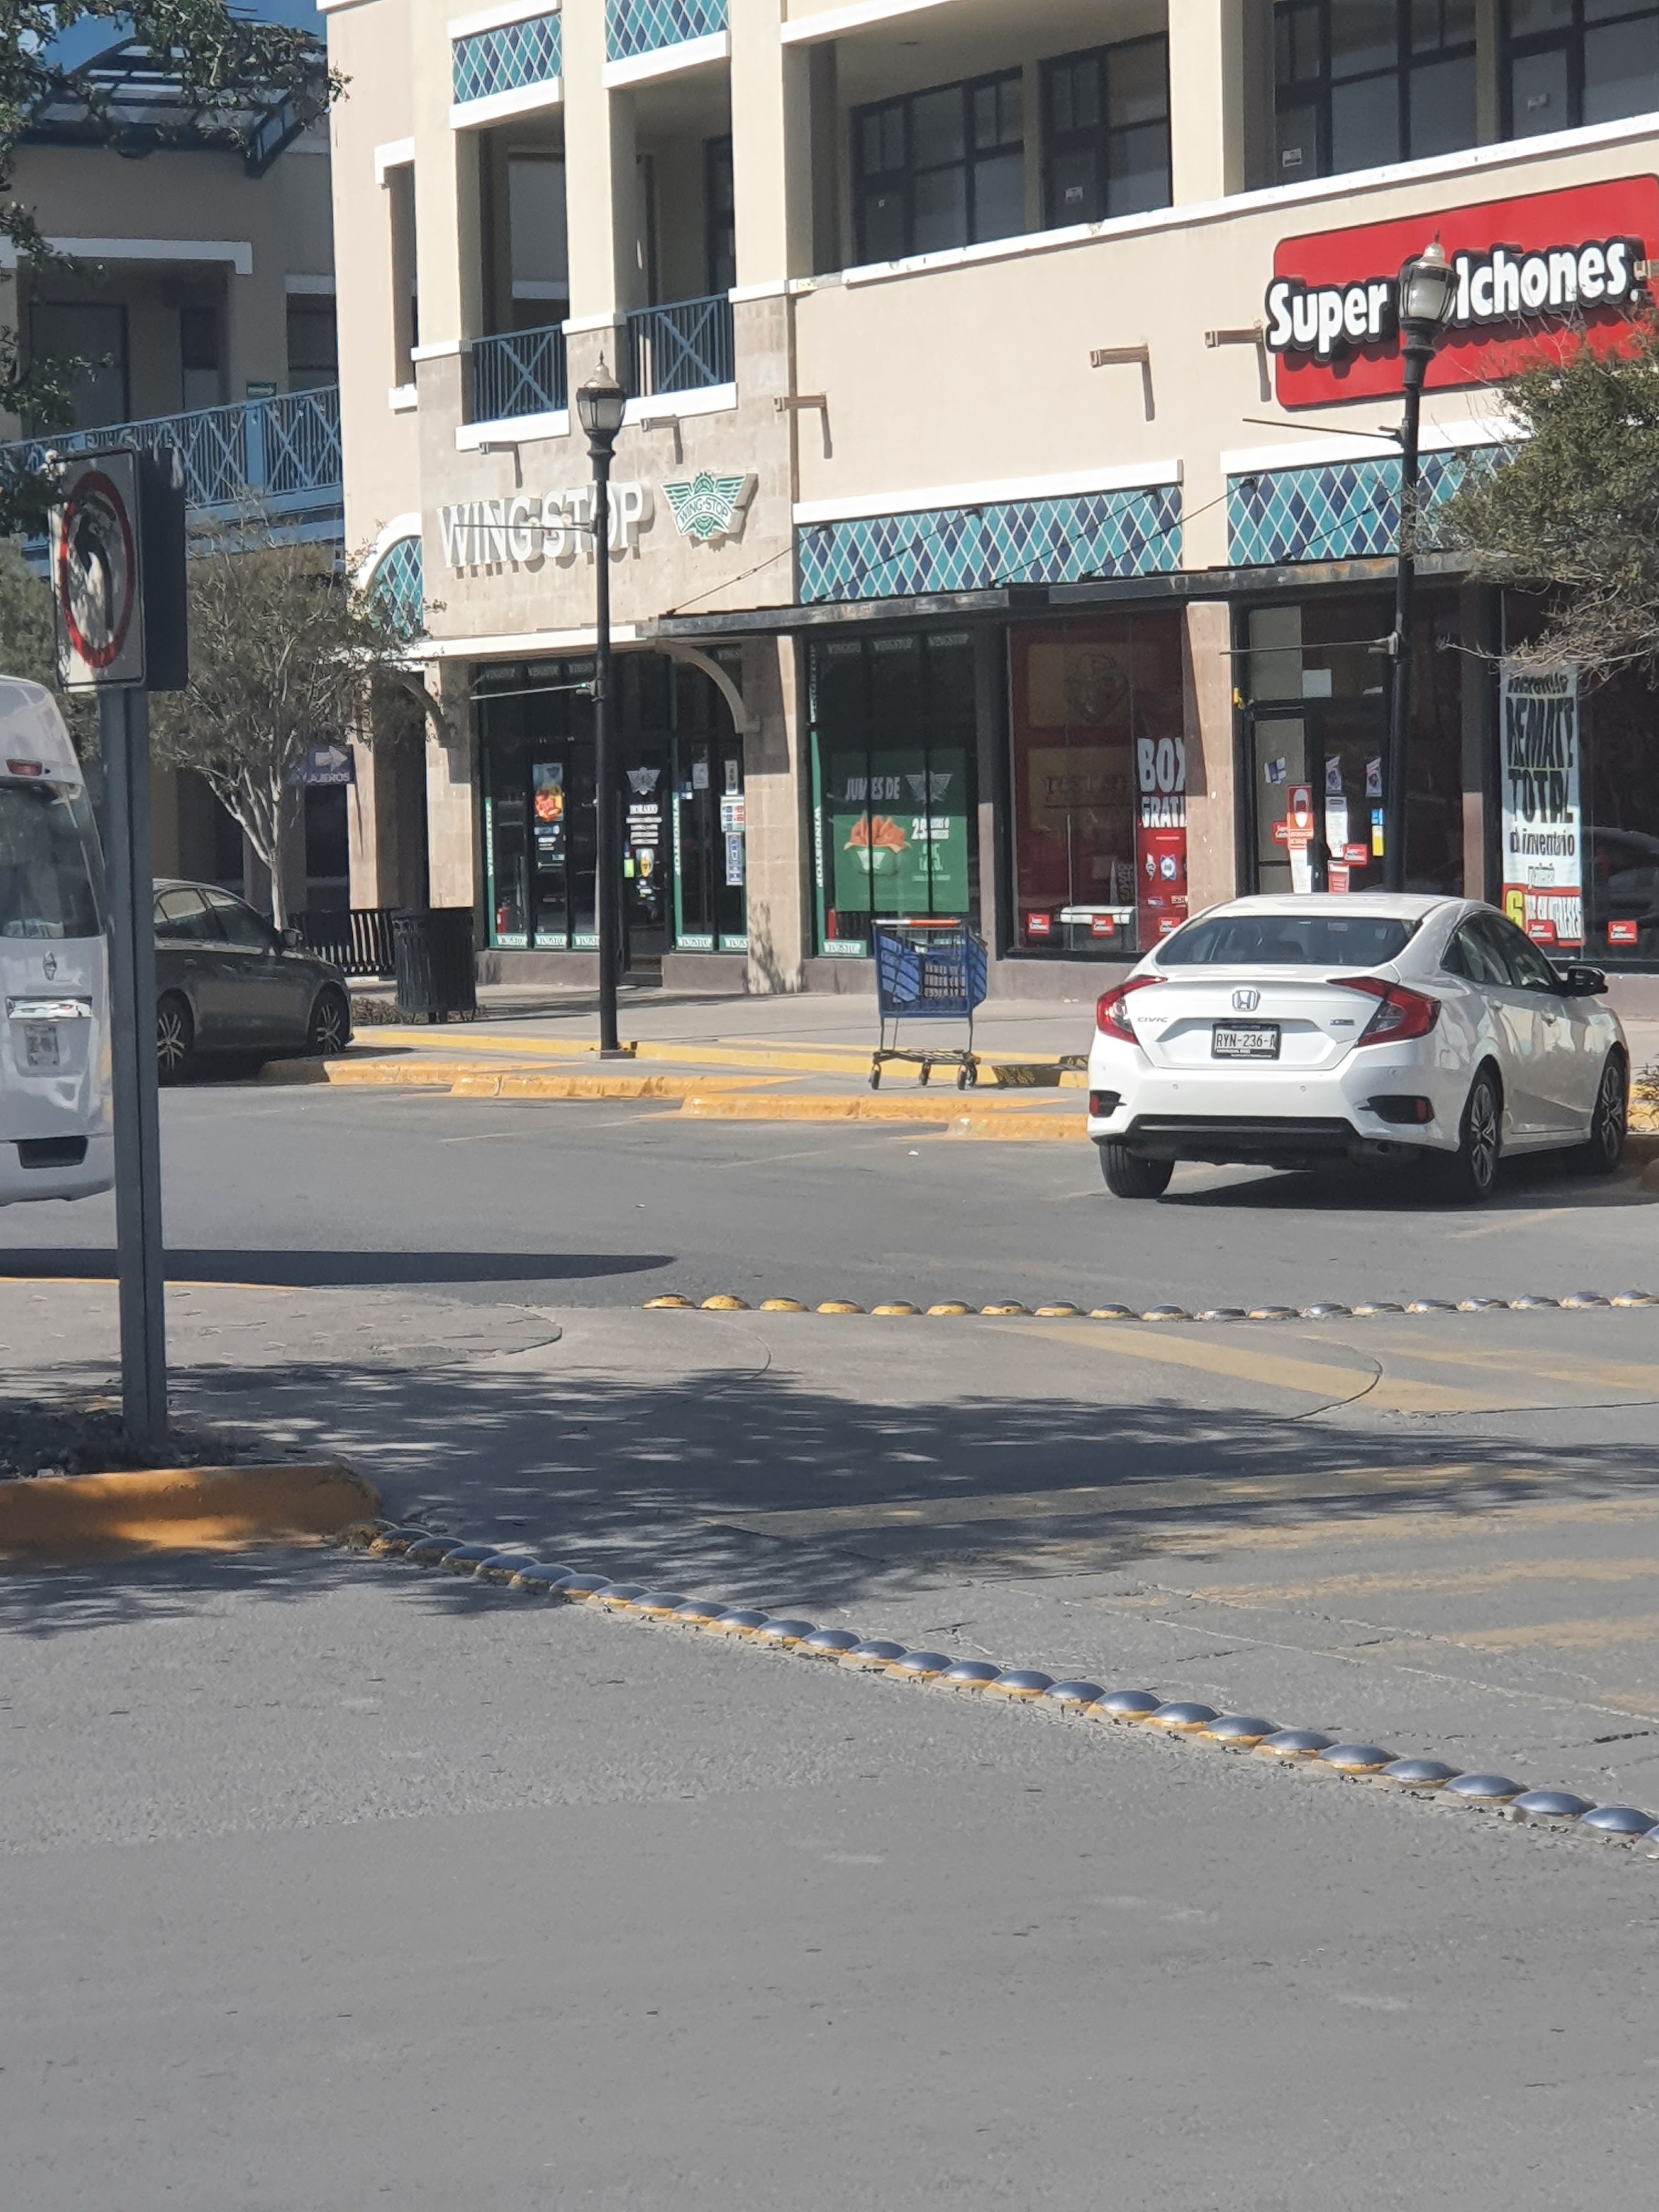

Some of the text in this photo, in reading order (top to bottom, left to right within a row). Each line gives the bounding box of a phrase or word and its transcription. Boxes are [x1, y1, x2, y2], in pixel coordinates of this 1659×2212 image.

[1269, 283, 1388, 353] Super
[885, 776, 901, 800] DE
[1508, 769, 1573, 823] TOTAL
[1142, 795, 1187, 828] GRATI
